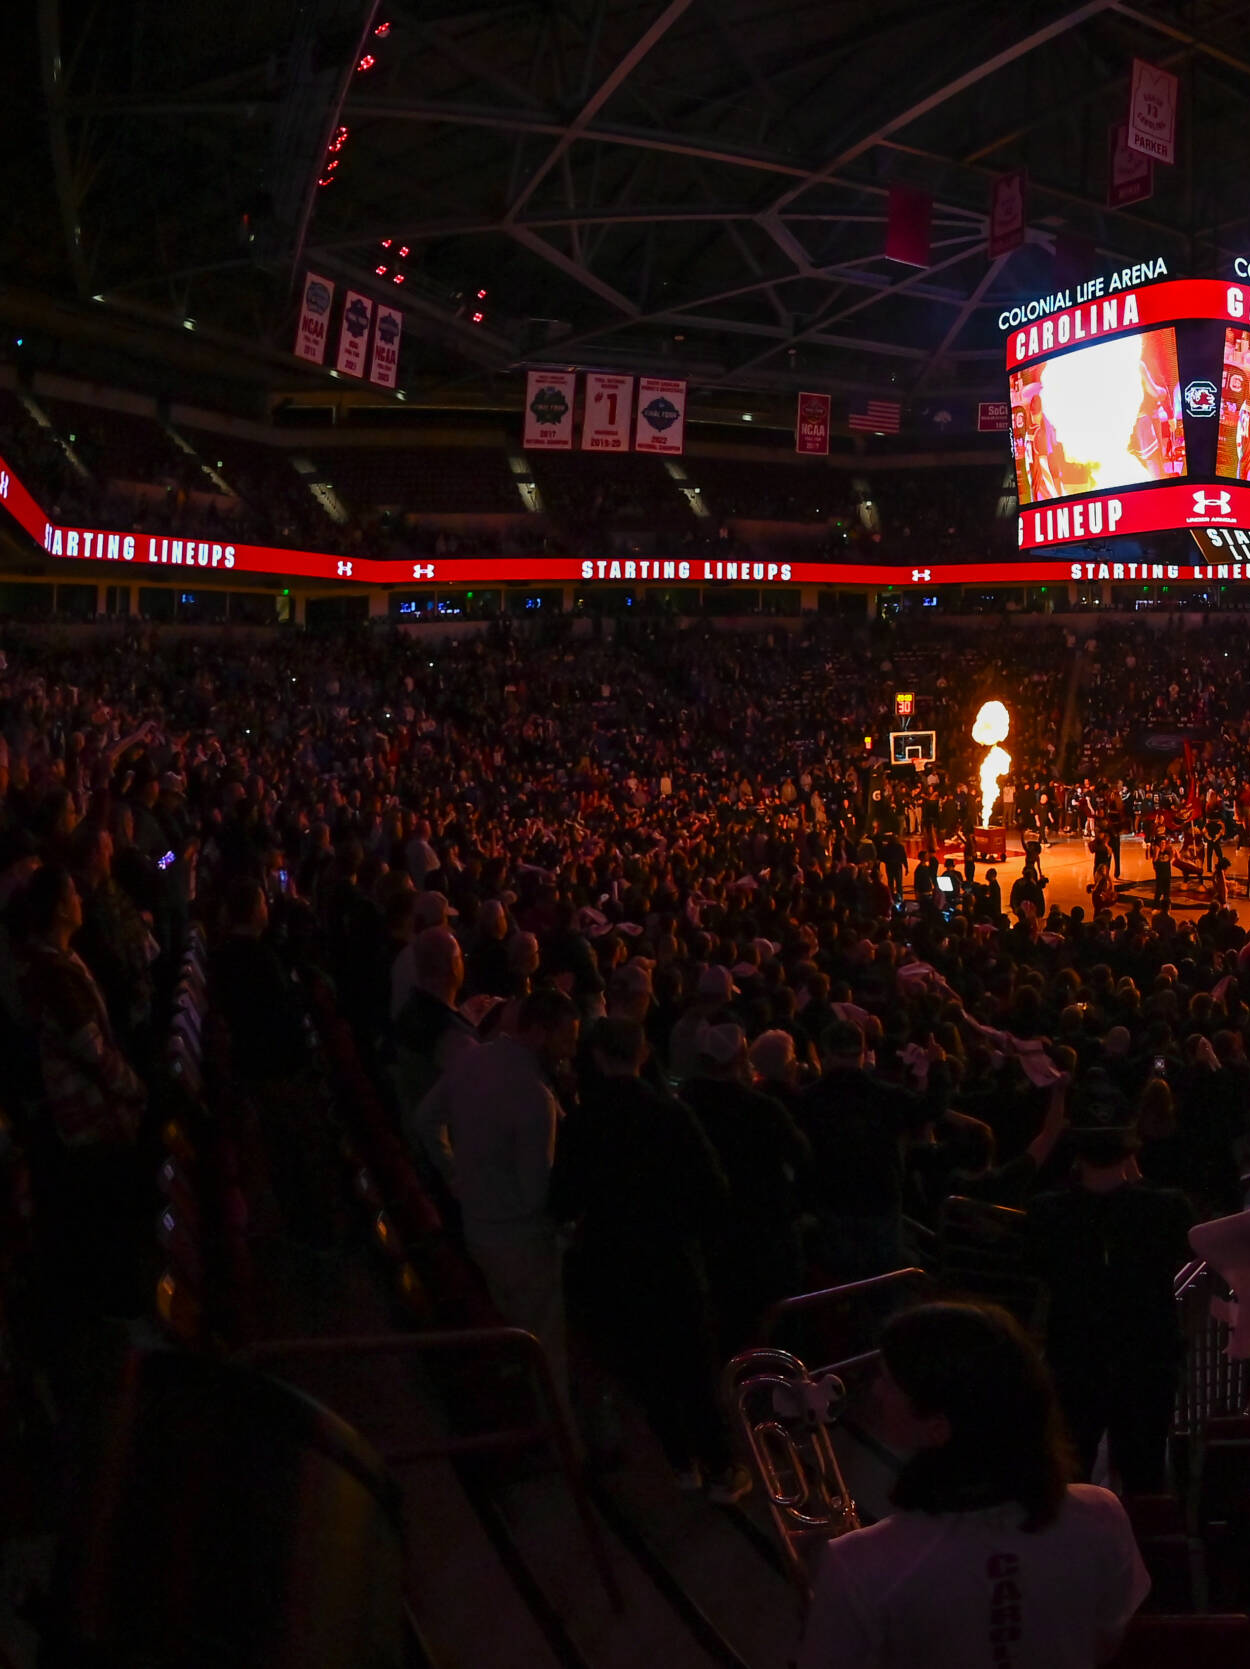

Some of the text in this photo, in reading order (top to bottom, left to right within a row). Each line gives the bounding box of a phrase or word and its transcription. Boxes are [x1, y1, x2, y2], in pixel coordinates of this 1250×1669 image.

[1134, 134, 1168, 156] PARKER
[998, 257, 1168, 331] COLONIAL LIFE ARENA
[302, 315, 325, 339] NCAA
[1015, 294, 1140, 361] CAROLINA
[375, 344, 397, 365] NCAA
[540, 430, 557, 439] 2017
[801, 423, 825, 437] NCAA
[1034, 499, 1123, 543] LINEUP
[148, 537, 236, 568] LINEUPS
[581, 560, 792, 581] STARTING LINEUPS
[1070, 563, 1179, 580] STARTING
[898, 701, 911, 713] 30
